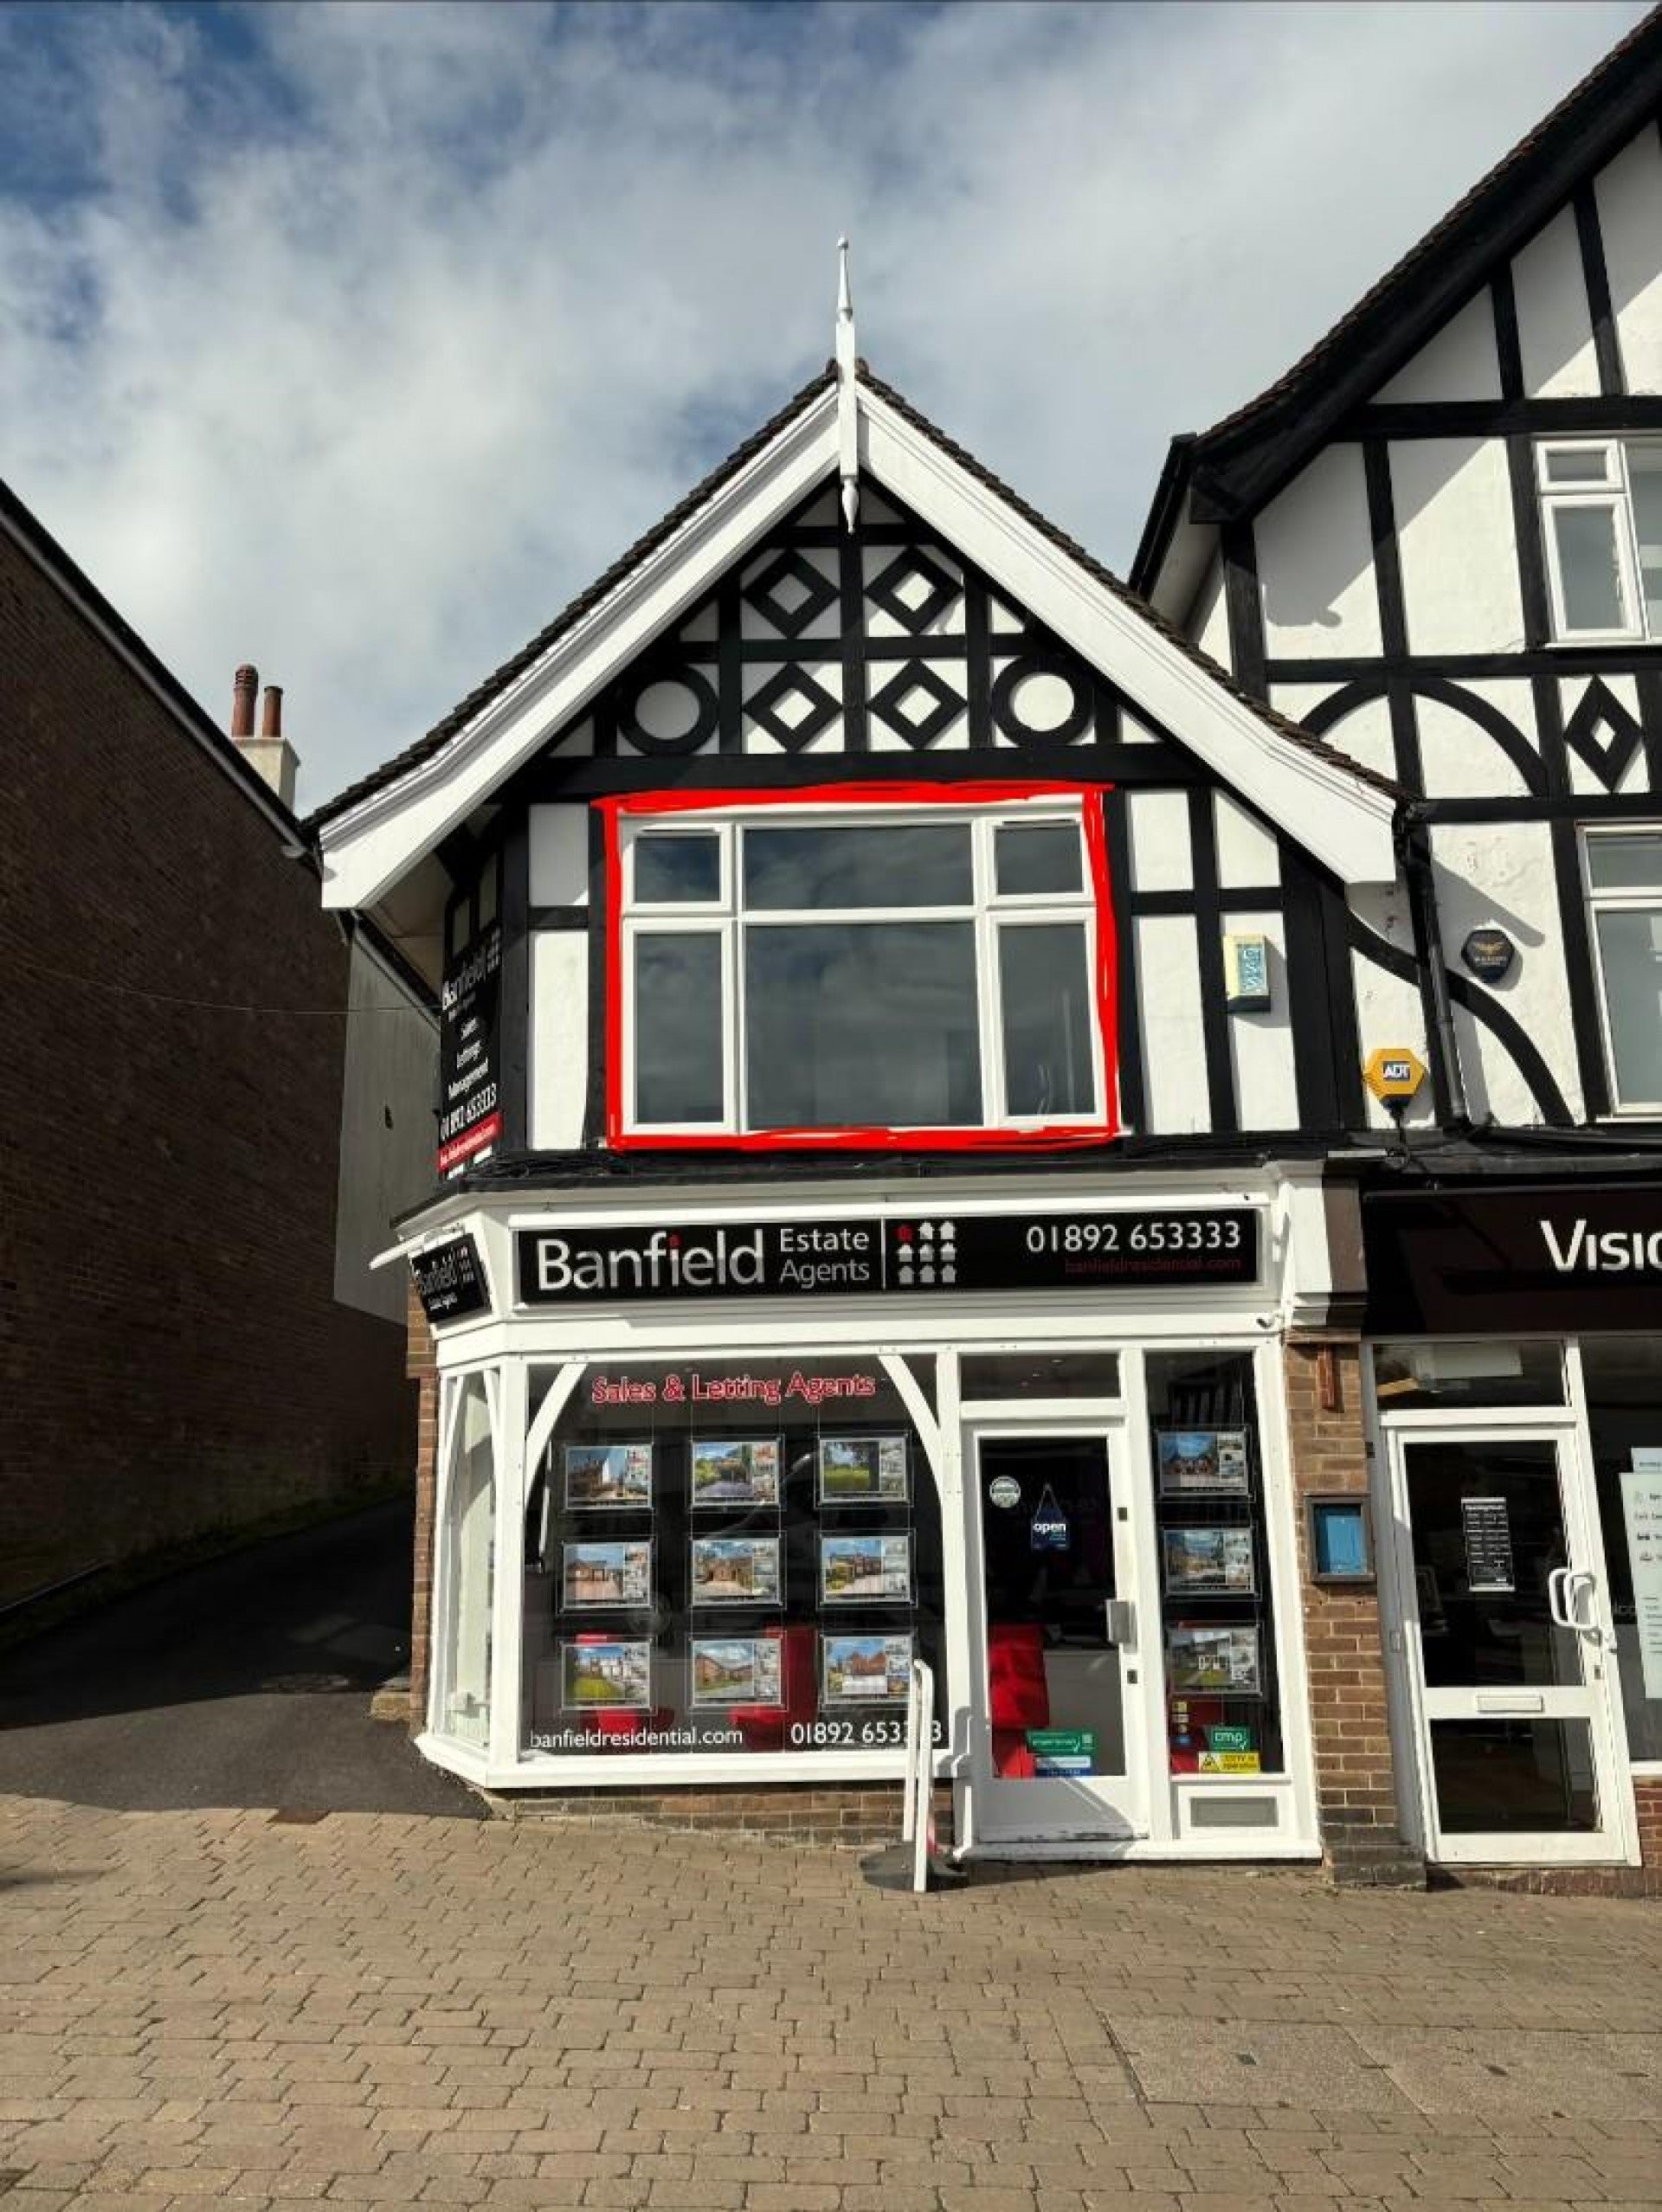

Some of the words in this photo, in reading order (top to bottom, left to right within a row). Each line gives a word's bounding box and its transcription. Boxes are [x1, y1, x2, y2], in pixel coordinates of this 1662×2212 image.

[1384, 1064, 1410, 1079] ADT
[1027, 1224, 1119, 1252] 01892
[1130, 1220, 1240, 1249] 653333
[537, 1229, 765, 1290] Banfield
[780, 1228, 869, 1251] Estate
[780, 1257, 869, 1289] Agents
[592, 1376, 656, 1404] Sales
[662, 1373, 686, 1403] &
[692, 1373, 782, 1405] Letting
[785, 1370, 876, 1404] Agents
[1033, 1524, 1066, 1534] open
[531, 1727, 743, 1748] banfieldresidential.com
[790, 1721, 855, 1744] 01892
[862, 1720, 942, 1744] 6533
